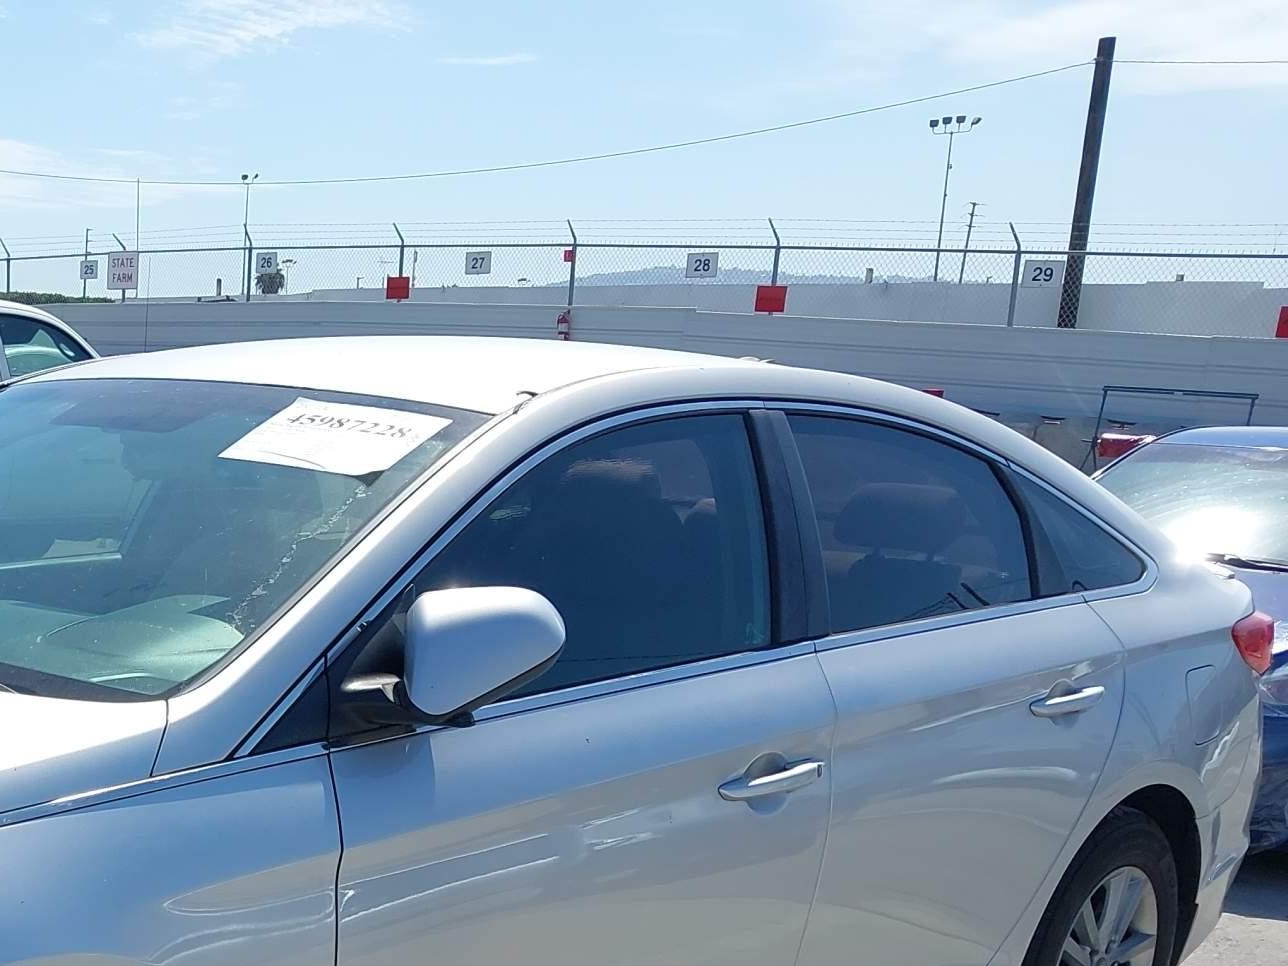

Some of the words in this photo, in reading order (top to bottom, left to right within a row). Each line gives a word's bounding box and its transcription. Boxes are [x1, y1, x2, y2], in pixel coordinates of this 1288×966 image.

[112, 257, 134, 268] STATE
[260, 257, 272, 268] 26
[471, 257, 485, 270] 27
[694, 258, 711, 272] 28
[84, 265, 94, 275] 25
[1031, 267, 1054, 282] 29
[113, 272, 133, 282] FARM
[287, 413, 412, 438] 45987228
